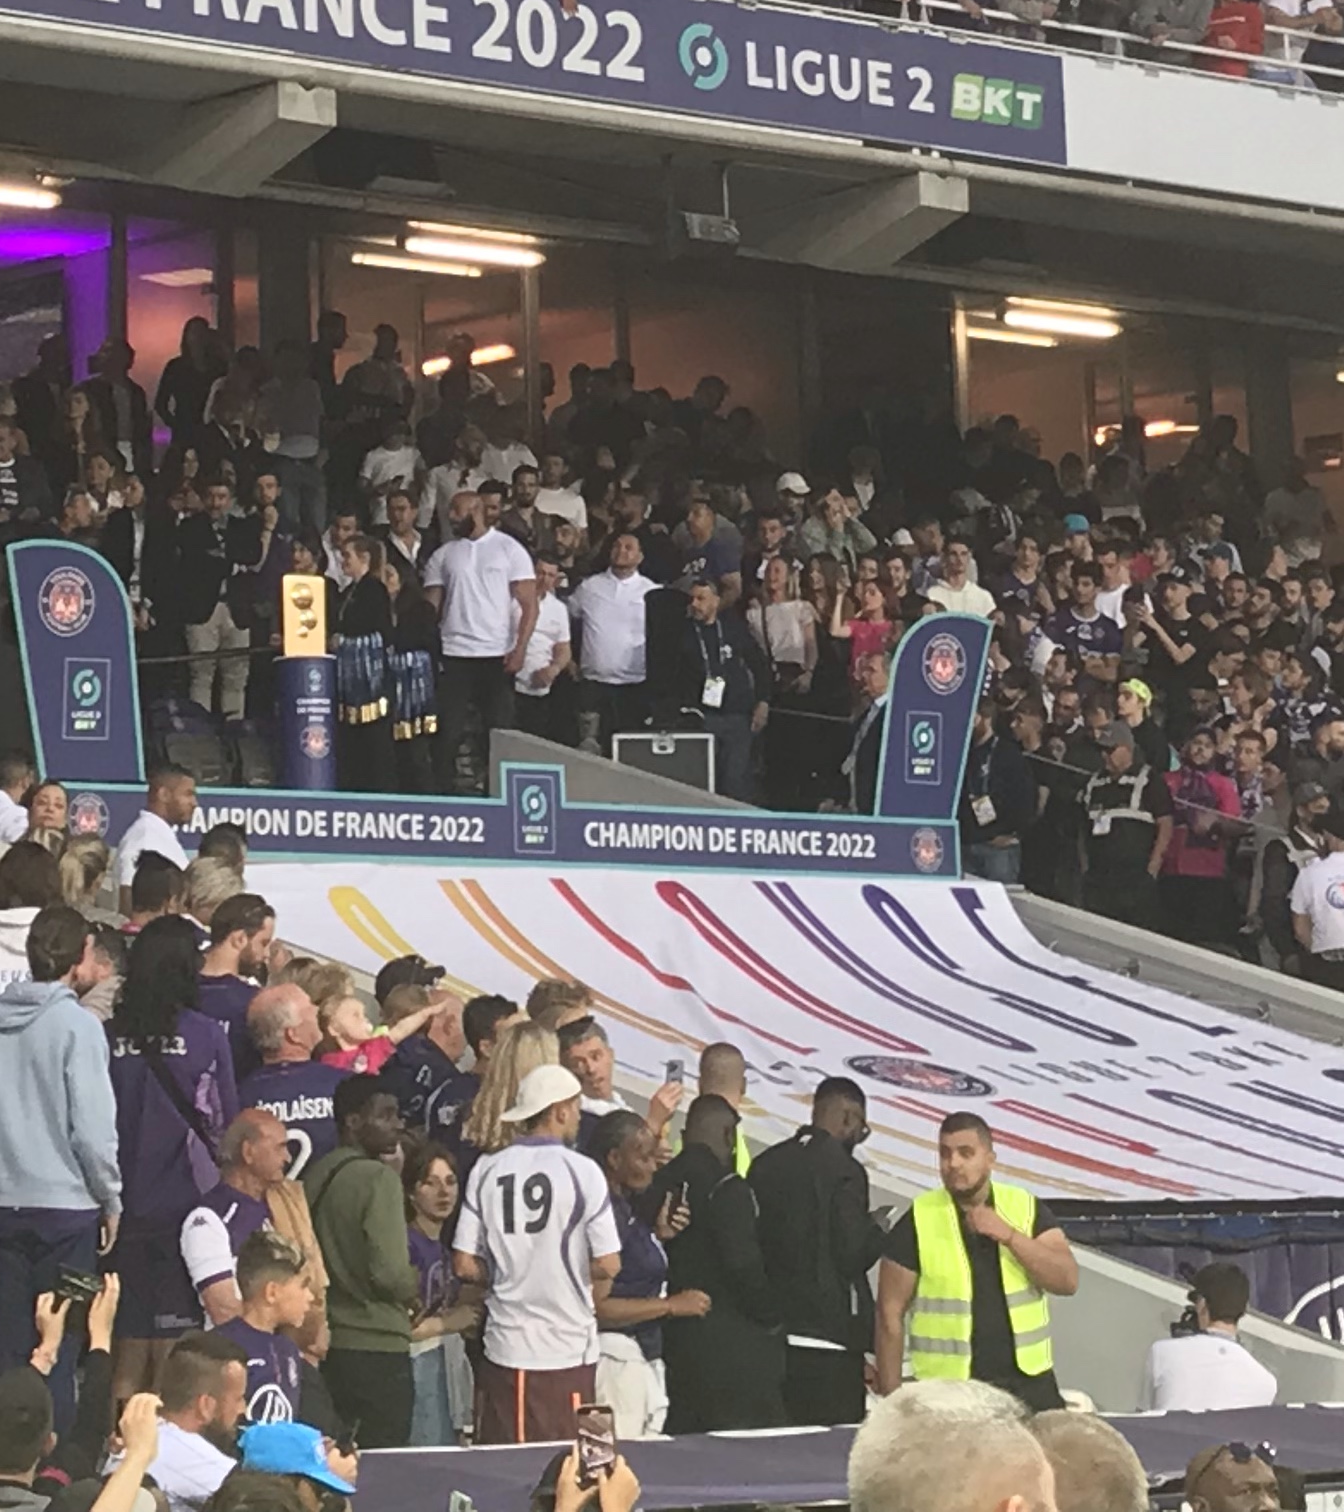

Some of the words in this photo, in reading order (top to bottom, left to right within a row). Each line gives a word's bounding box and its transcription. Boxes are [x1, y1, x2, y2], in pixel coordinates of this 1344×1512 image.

[745, 40, 895, 107] LIGUE
[906, 66, 936, 114] 2
[953, 77, 1043, 121] BKT
[172, 807, 290, 836] AMPION
[295, 809, 328, 837] DE
[332, 811, 425, 842] FRANCE
[429, 816, 485, 842] 2022
[583, 821, 704, 852] CHAMPION
[708, 826, 738, 853] DE
[741, 828, 823, 857] FRANCE
[825, 832, 877, 858] 2022
[496, 1171, 553, 1234] 19
